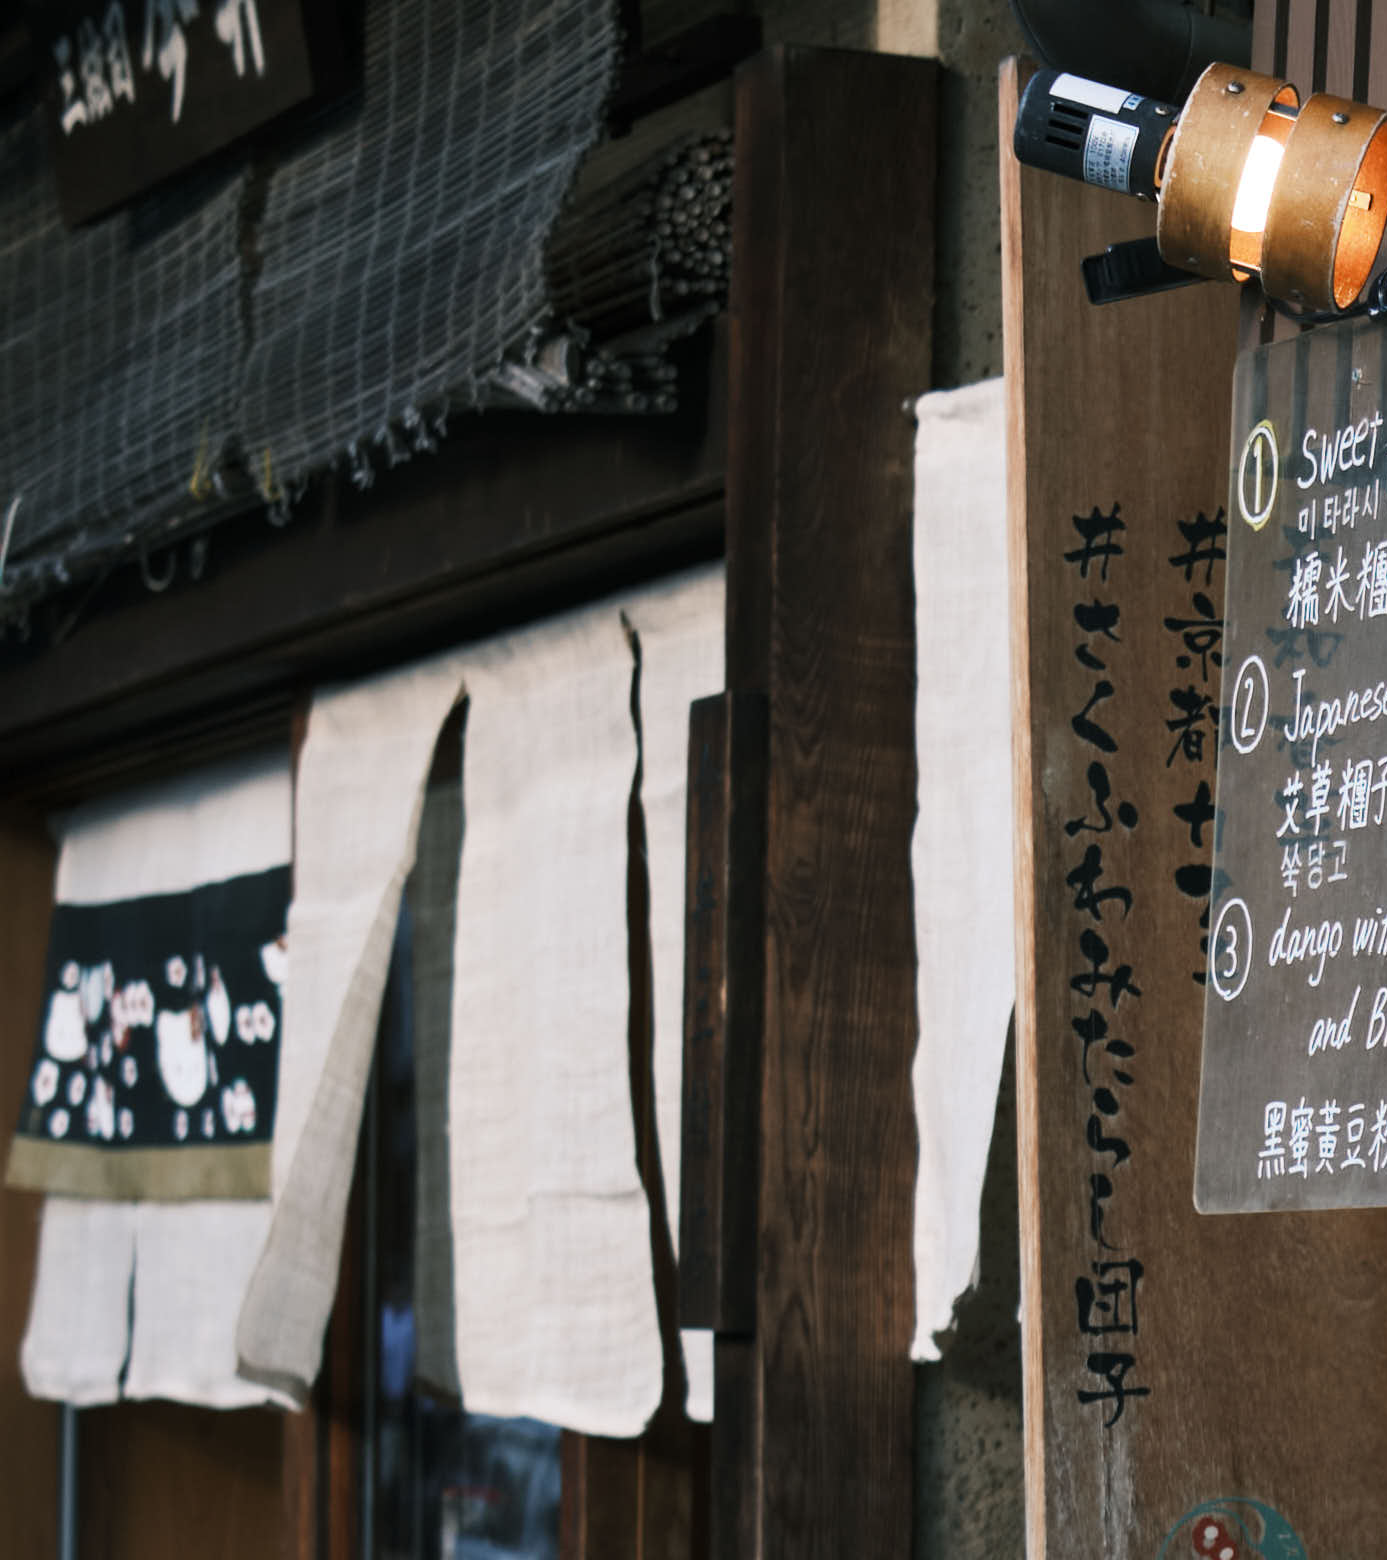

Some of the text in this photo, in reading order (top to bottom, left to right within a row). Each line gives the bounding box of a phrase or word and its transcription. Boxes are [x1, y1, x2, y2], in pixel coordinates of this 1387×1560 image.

[1297, 408, 1384, 490] Sweet
[1268, 906, 1343, 987] dango
[1307, 985, 1361, 1057] and
